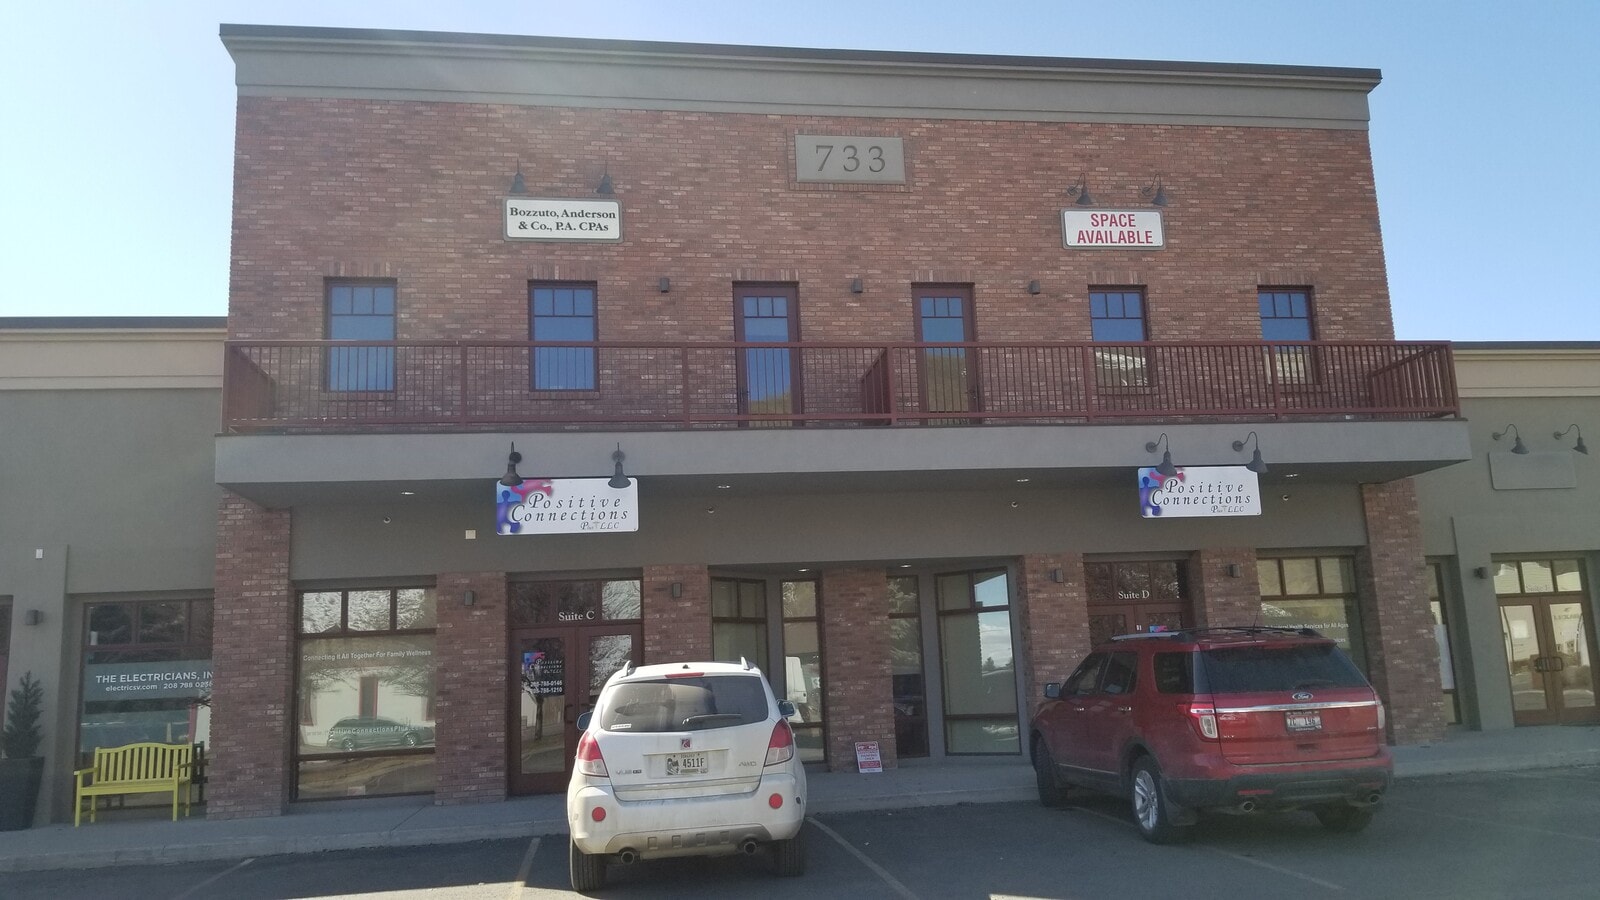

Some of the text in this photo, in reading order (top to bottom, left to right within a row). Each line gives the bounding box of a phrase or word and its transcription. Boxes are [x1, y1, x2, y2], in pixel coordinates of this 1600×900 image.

[815, 144, 886, 173] 733
[509, 207, 616, 219] Bozzuto, Anderson
[518, 221, 609, 232] & Co., P.A. CPAs
[1090, 213, 1136, 227] SPACE
[1077, 230, 1153, 244] AVAILABLE
[1165, 478, 1244, 494] Positive
[528, 492, 621, 509] Positive
[1152, 489, 1251, 506] Connections
[511, 504, 628, 522] Connections
[1118, 589, 1150, 600] Suite D
[558, 610, 595, 621] Suite C
[303, 654, 336, 662] Connecting
[350, 651, 376, 660] Together
[386, 650, 405, 658] Family
[95, 674, 117, 684] THE
[119, 671, 200, 683] ELECTRICIANS,
[105, 684, 158, 692] electricsv.com
[163, 682, 178, 690] 208
[179, 681, 193, 689] 788
[682, 757, 705, 769] 4511F
